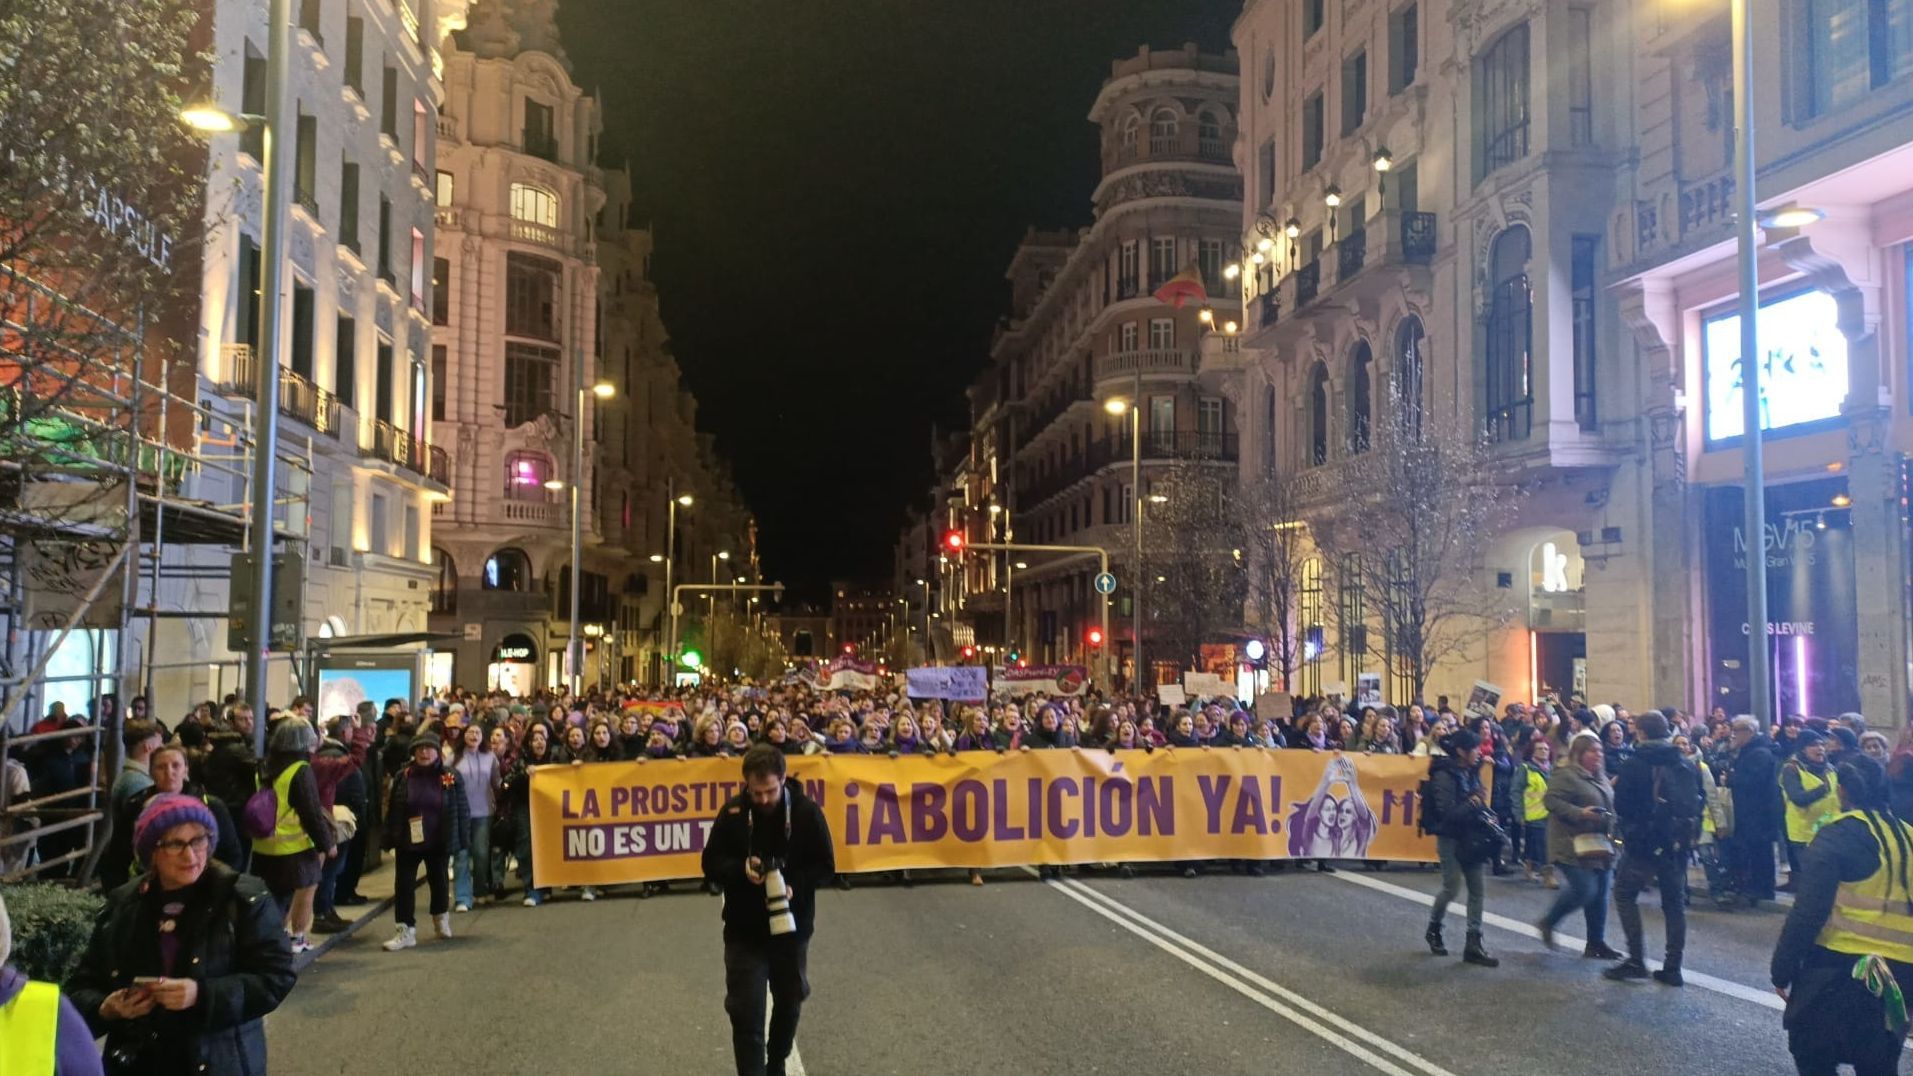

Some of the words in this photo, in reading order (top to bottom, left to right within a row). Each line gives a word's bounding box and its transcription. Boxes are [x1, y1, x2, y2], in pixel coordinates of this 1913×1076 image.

[1775, 622, 1815, 635] LEVINE
[562, 788, 601, 820] LA
[610, 773, 825, 817] PROSTITN
[845, 762, 1175, 846] ¡ABOLICIÓN
[1197, 775, 1282, 835] YA!
[568, 828, 605, 857] NO
[613, 825, 647, 855] ES
[654, 822, 691, 850] UN
